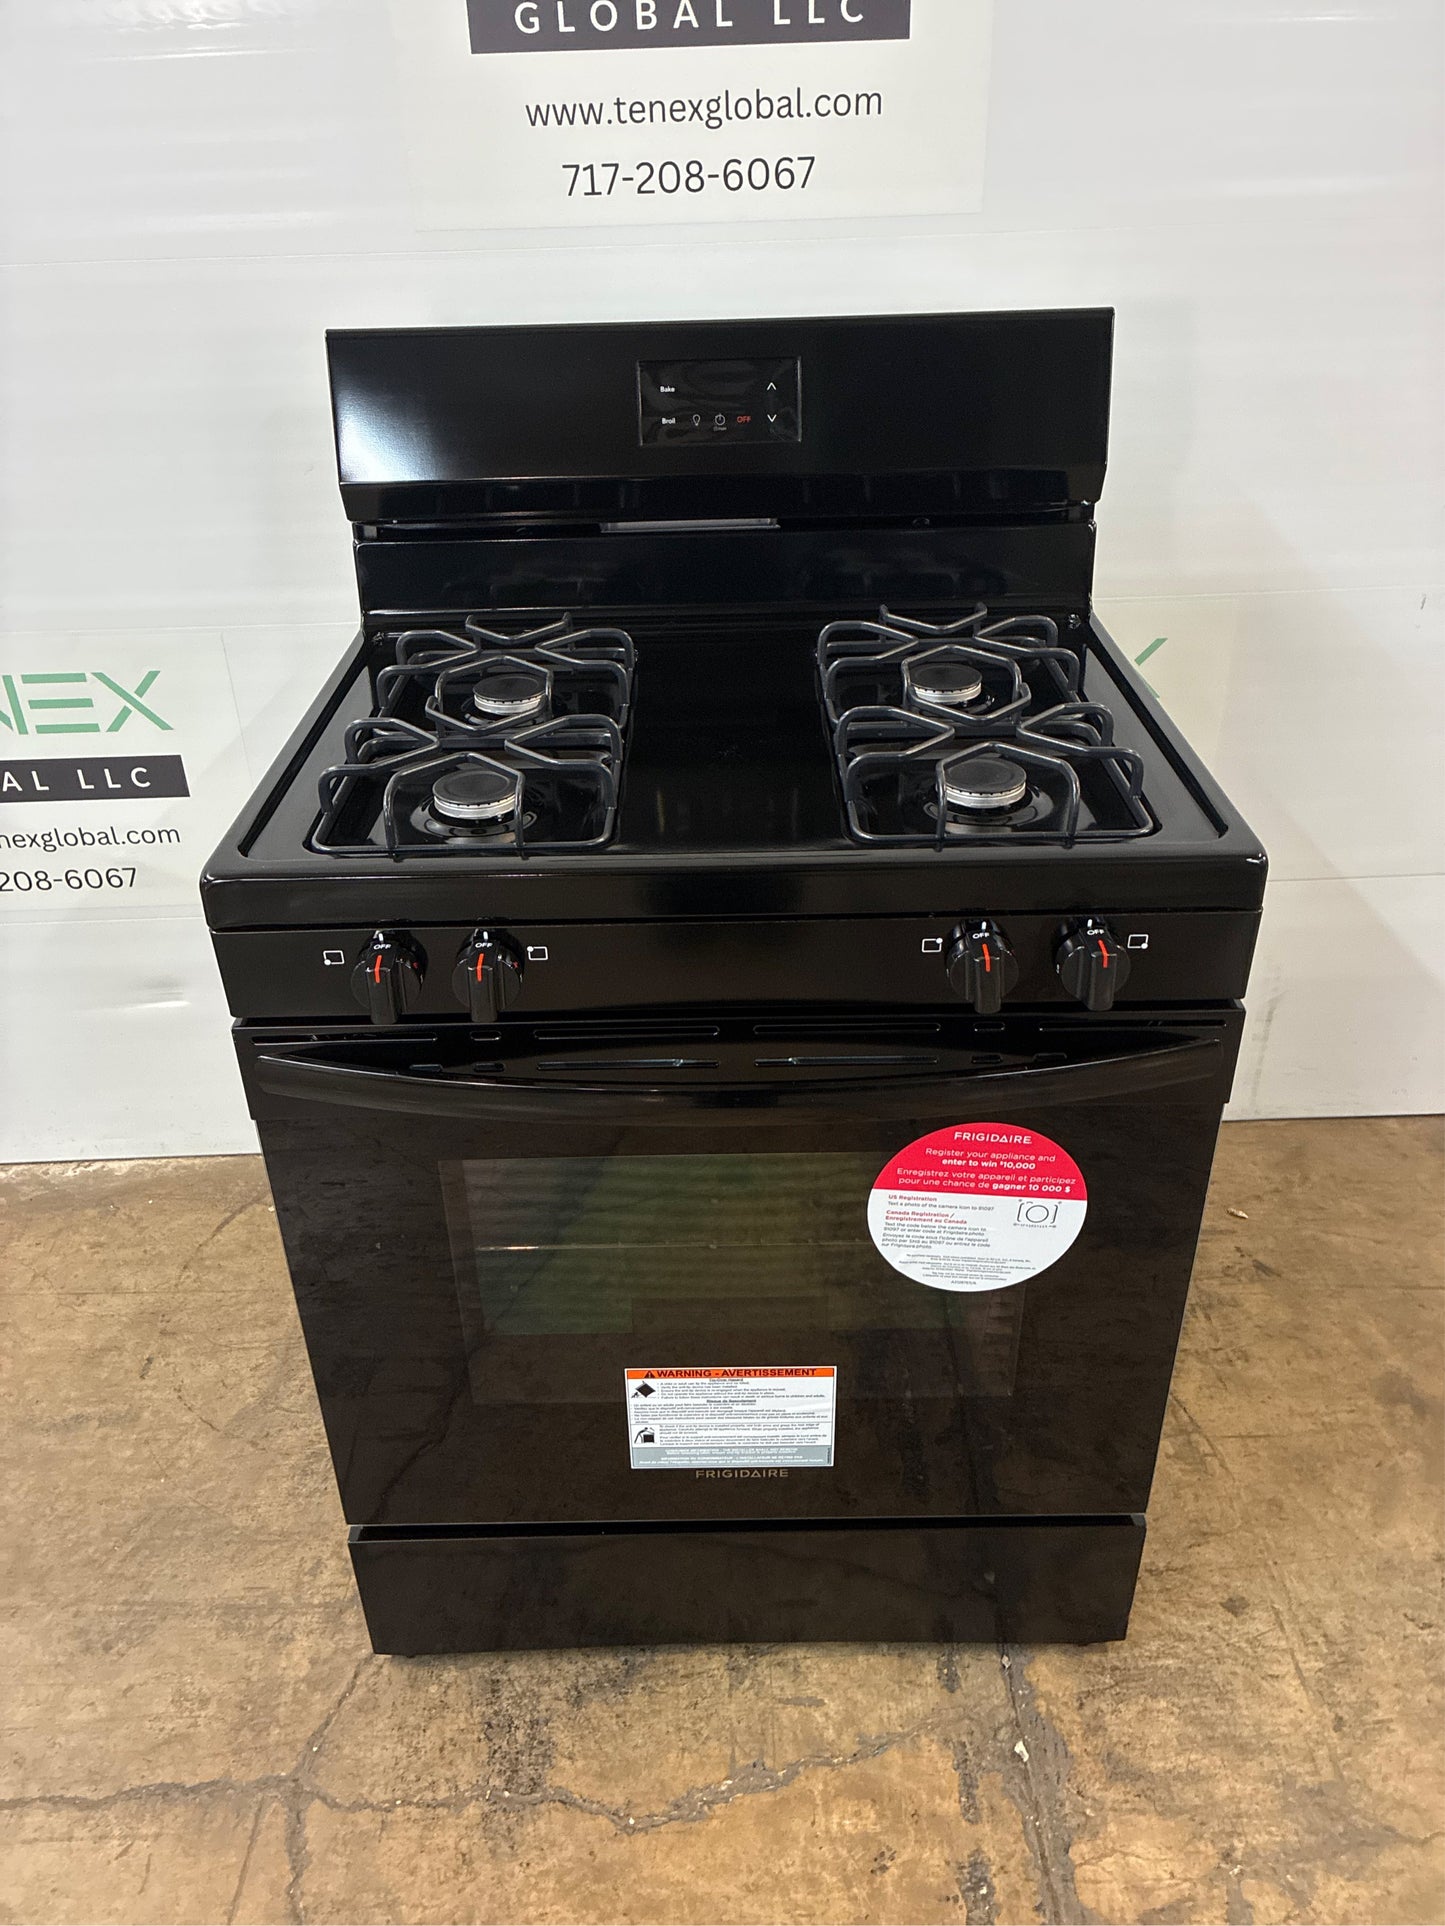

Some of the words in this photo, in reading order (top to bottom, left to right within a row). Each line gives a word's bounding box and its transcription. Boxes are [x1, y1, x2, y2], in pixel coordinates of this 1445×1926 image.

[514, 0, 734, 34] GLOBAL
[773, 0, 864, 25] LLC
[525, 87, 883, 129] www.tenexglobal.com
[562, 156, 816, 196] 717-208-6067
[660, 385, 675, 393] Bake
[661, 417, 676, 425] Broil
[737, 415, 752, 423] OFF
[2, 770, 50, 792] AL
[77, 767, 151, 790] LLC
[972, 931, 990, 939] OFF
[1086, 928, 1105, 936] OFF
[474, 941, 493, 949] OFF
[954, 1131, 1032, 1144] FRIGIDAIRE
[925, 1148, 964, 1157] Register
[967, 1151, 987, 1159] your
[990, 1152, 1035, 1162] appliance
[1037, 1154, 1056, 1162] and
[942, 1158, 966, 1166] enter
[968, 1159, 978, 1167] to
[981, 1160, 997, 1168] win
[1000, 1161, 1036, 1170] $10,000
[896, 1168, 949, 1178] Enregistrez
[952, 1171, 975, 1179] votre
[978, 1173, 1015, 1182] appareil
[1029, 1176, 1076, 1185] participez
[898, 1177, 920, 1185] pour
[942, 1179, 975, 1188] chance
[992, 1183, 1026, 1191] gagner
[1041, 1185, 1062, 1193] 000
[1064, 1185, 1071, 1193] $
[885, 1215, 933, 1223] Enregistrement
[656, 1369, 712, 1378] WARNING
[721, 1368, 817, 1377] AVERTISSEMENT
[695, 1468, 789, 1479] FRIGIDAIRE
